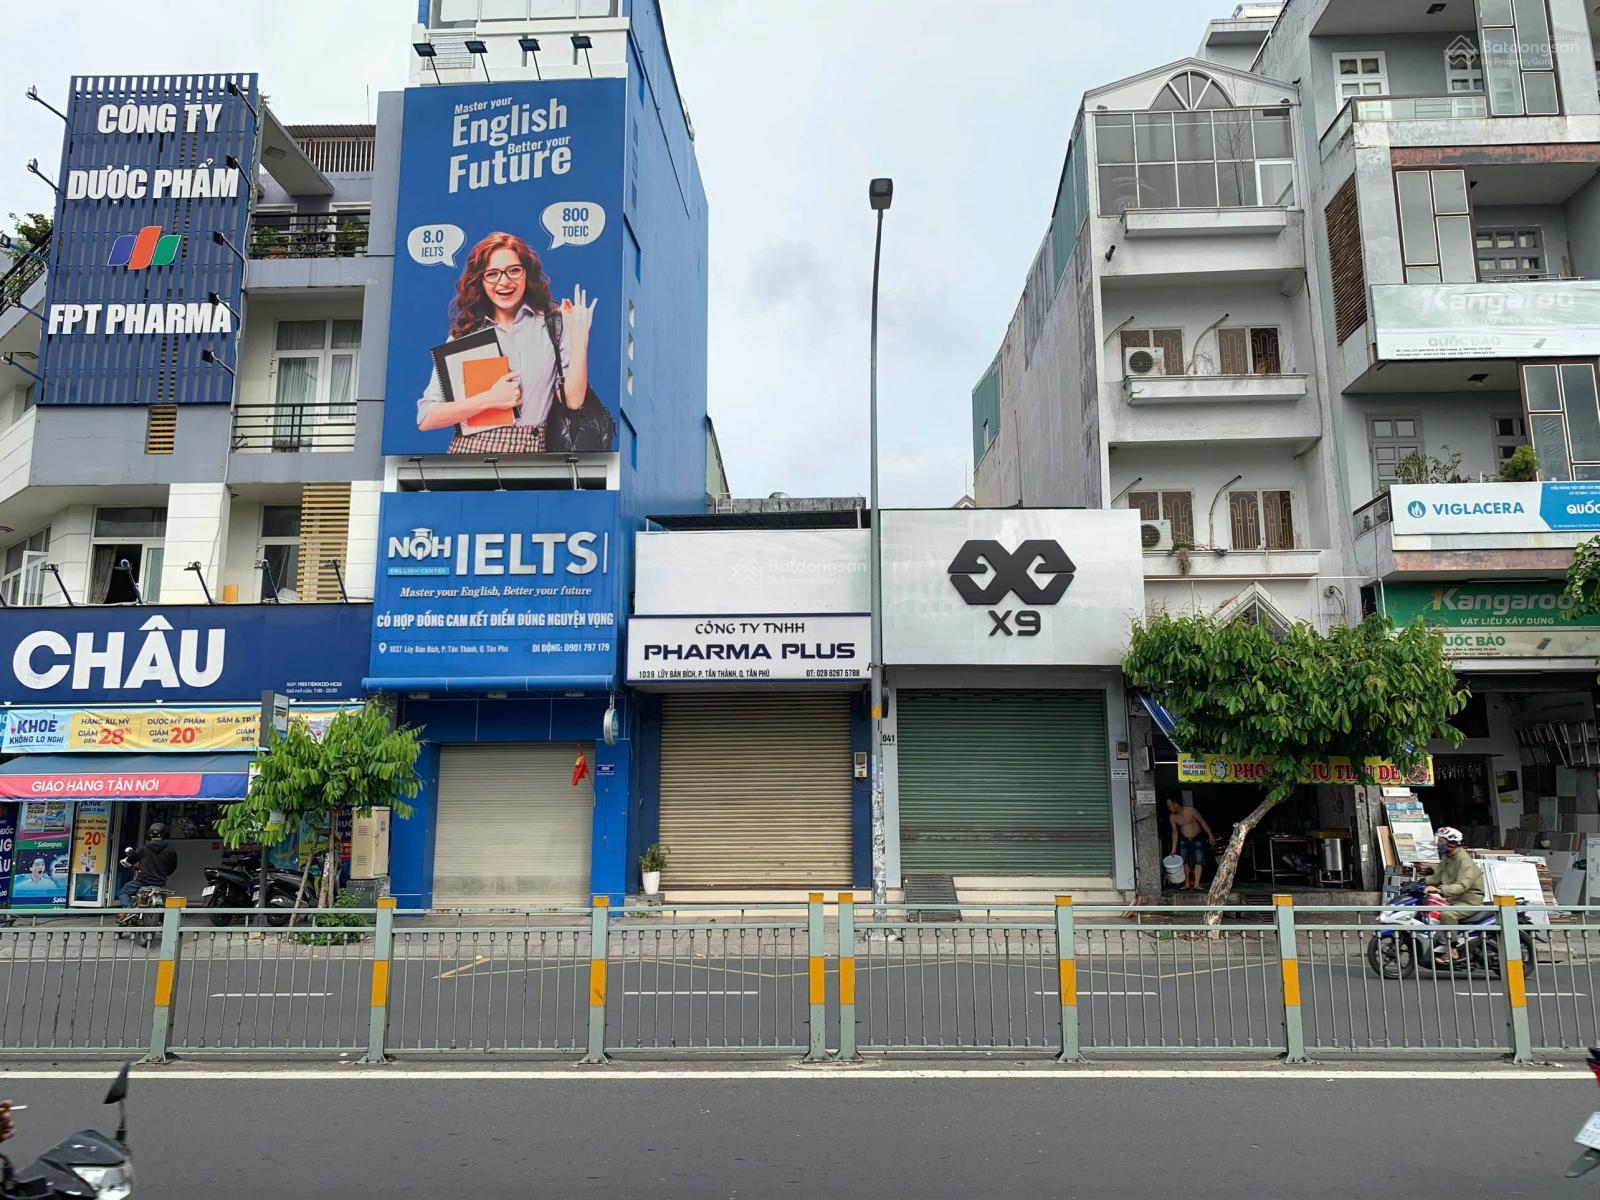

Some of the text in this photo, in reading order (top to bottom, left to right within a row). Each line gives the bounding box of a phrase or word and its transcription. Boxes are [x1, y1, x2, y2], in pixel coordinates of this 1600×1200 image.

[454, 95, 512, 115] Master your
[98, 98, 224, 134] CÔNG TY
[452, 98, 567, 148] English
[508, 136, 571, 155] Better your
[449, 145, 571, 194] Future
[67, 158, 240, 205] DƯỢC PHẨM
[562, 207, 589, 222] 800
[423, 229, 444, 244] 8.0
[562, 225, 589, 238] TOEIC
[421, 246, 444, 258] IELTS
[1420, 286, 1576, 315] Kangaroo
[48, 302, 232, 335] FPT PHARMA
[1432, 502, 1524, 515] VIGLACERA
[456, 531, 597, 576] IELTS
[400, 585, 592, 599] Master your English, Better your future
[1432, 588, 1576, 615] Kangaroo
[377, 611, 391, 628] CÓ
[393, 613, 415, 630] HỢP
[446, 613, 467, 628] CAM
[469, 610, 489, 628] KẾT
[490, 608, 516, 627] ĐIỂM
[517, 610, 545, 627] ĐÚNG
[547, 610, 586, 629] NGUYỆN
[587, 613, 614, 629] VỌNG
[988, 610, 1041, 637] X9
[1505, 616, 1525, 625] XÂY
[695, 620, 805, 635] CÔNG TY TNHH
[532, 643, 541, 652] DI
[564, 643, 582, 652] 0901
[584, 643, 596, 652] 797
[598, 642, 610, 652] 179
[1445, 633, 1506, 647] UỐC BẢO
[12, 614, 226, 691] CHÂU
[644, 643, 856, 660] PHARMA PLUS
[638, 670, 656, 679] 1039
[657, 669, 669, 678] LŨY
[670, 669, 682, 678] BÁN
[705, 669, 717, 678] TÂN
[746, 668, 758, 677] TÂN
[758, 668, 770, 677] PHÚ
[816, 669, 828, 677] 028
[118, 717, 130, 725] MỸ
[170, 716, 182, 725] MỸ
[216, 716, 234, 724] SÂM
[78, 729, 98, 737] GIẢM
[149, 729, 169, 737] GIẢM
[236, 727, 256, 735] GIẢM
[9, 734, 34, 745] KHÔNG
[36, 735, 46, 743] LO
[31, 776, 159, 796] GIAO HÀNG TẬN NƠI
[38, 841, 63, 849] Salonpas
